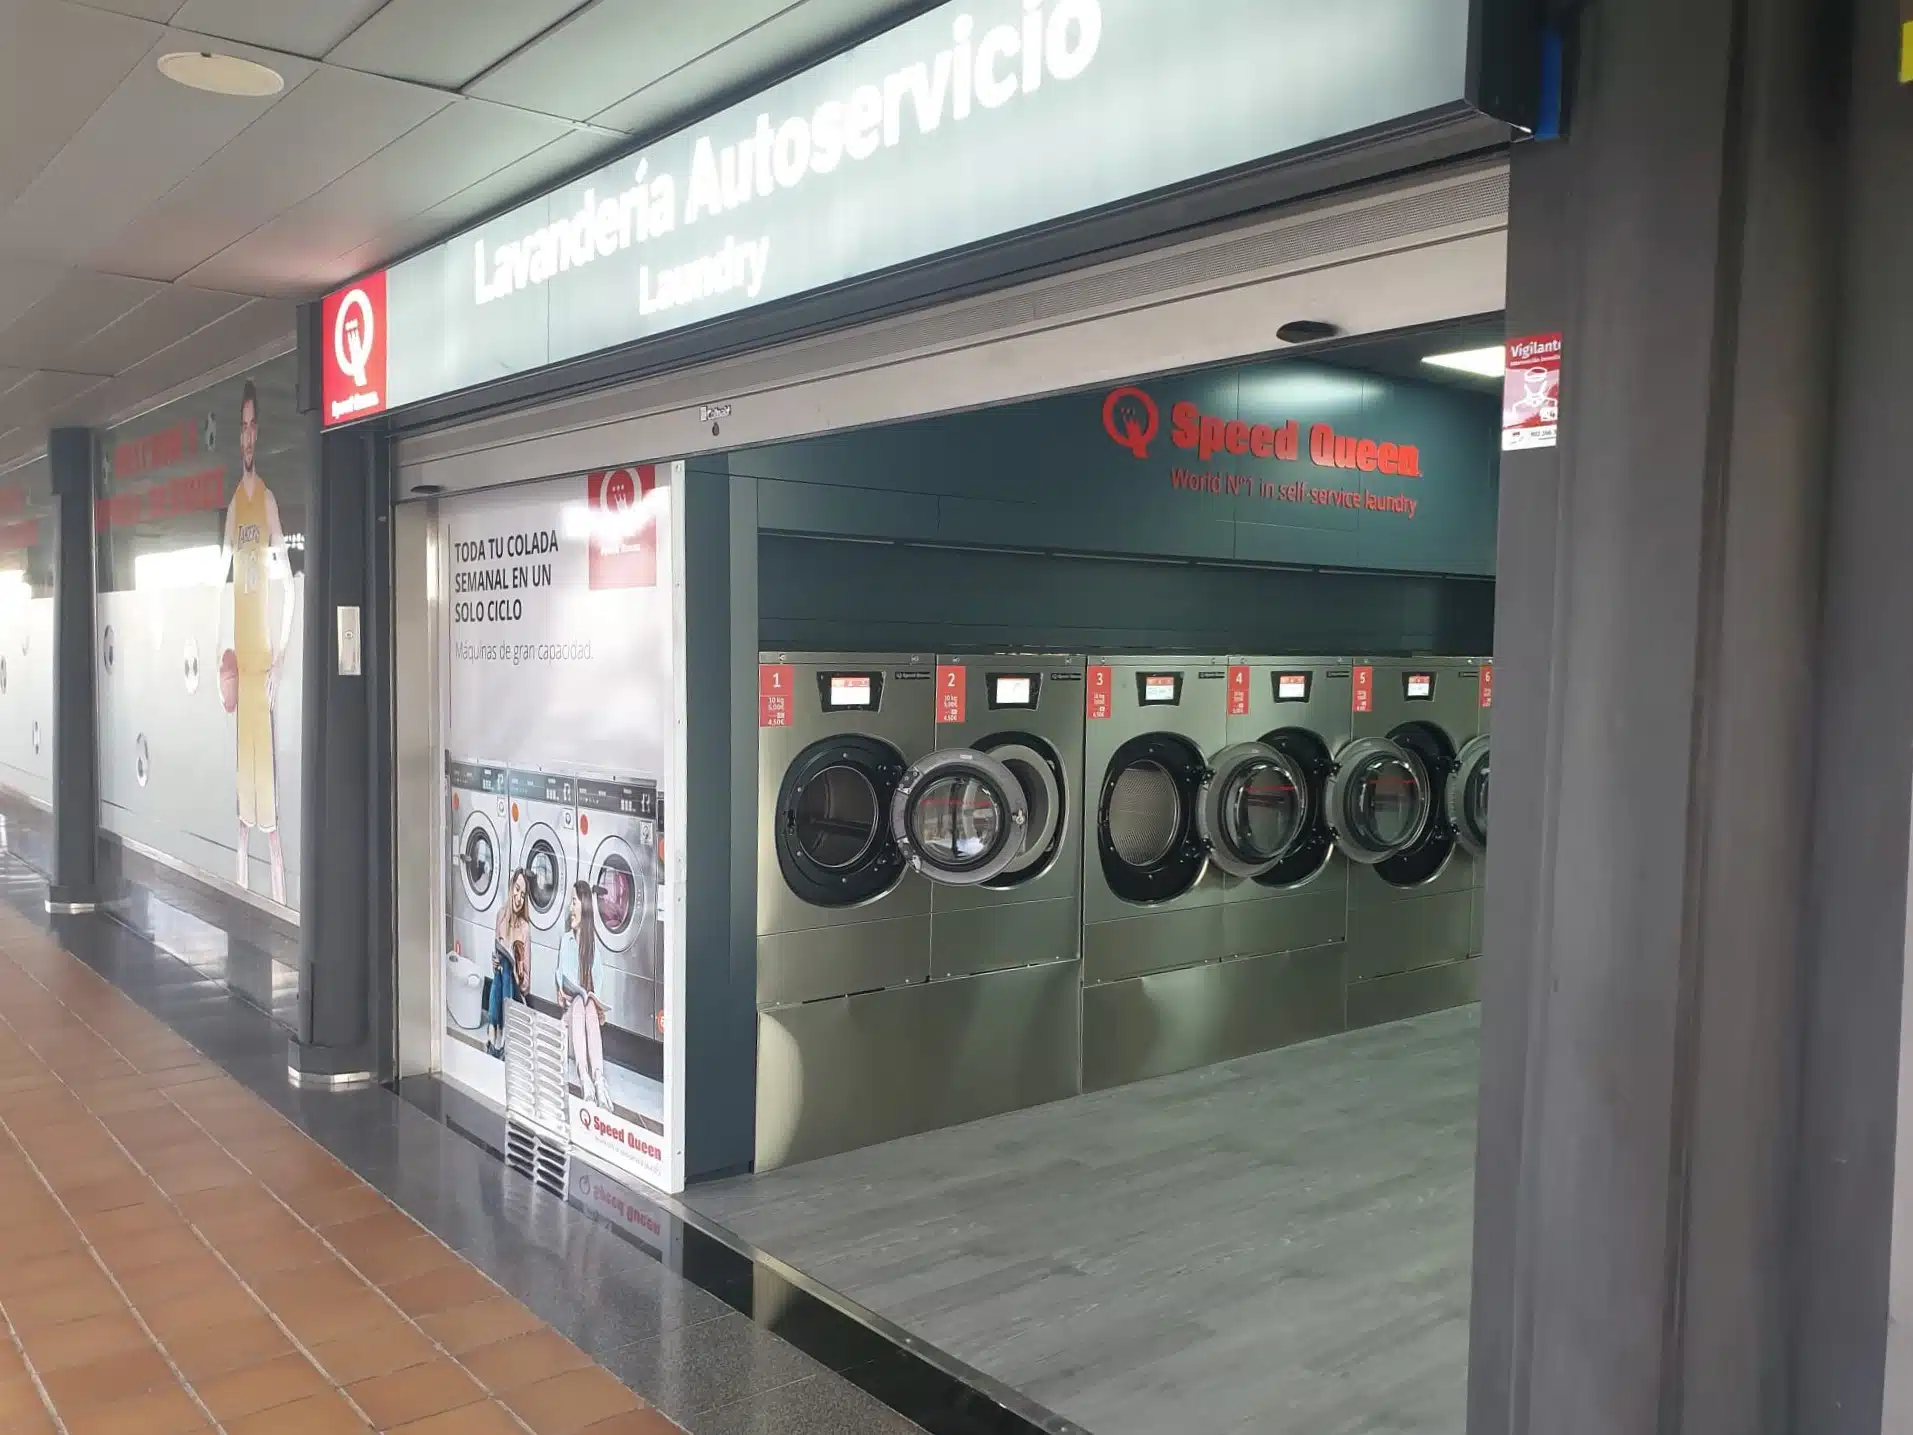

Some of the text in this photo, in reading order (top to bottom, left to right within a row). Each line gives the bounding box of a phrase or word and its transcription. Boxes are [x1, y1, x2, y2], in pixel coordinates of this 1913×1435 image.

[475, 0, 1101, 304] Lavandería Autoservicio
[640, 235, 770, 315] Laundry
[1171, 400, 1299, 460] Speed
[1309, 423, 1420, 477] Queen
[1171, 468, 1221, 493] World
[1260, 478, 1275, 499] in
[1279, 480, 1361, 508] self-service
[1364, 489, 1417, 519] laundry
[455, 530, 558, 563] TODA TU COLADA
[455, 564, 551, 593] SEMANAL EN UN
[455, 599, 522, 622] SOLO CICLO
[456, 640, 497, 664] Máquinas
[500, 639, 511, 660] de
[513, 645, 535, 665] gran
[772, 672, 781, 688] 1
[947, 672, 956, 687] 2
[1096, 672, 1104, 686] 3
[1235, 672, 1243, 685] 4
[1360, 671, 1366, 684] 5
[1485, 671, 1491, 682] 6
[593, 1115, 624, 1143] Speed
[627, 1131, 661, 1161] Queen
